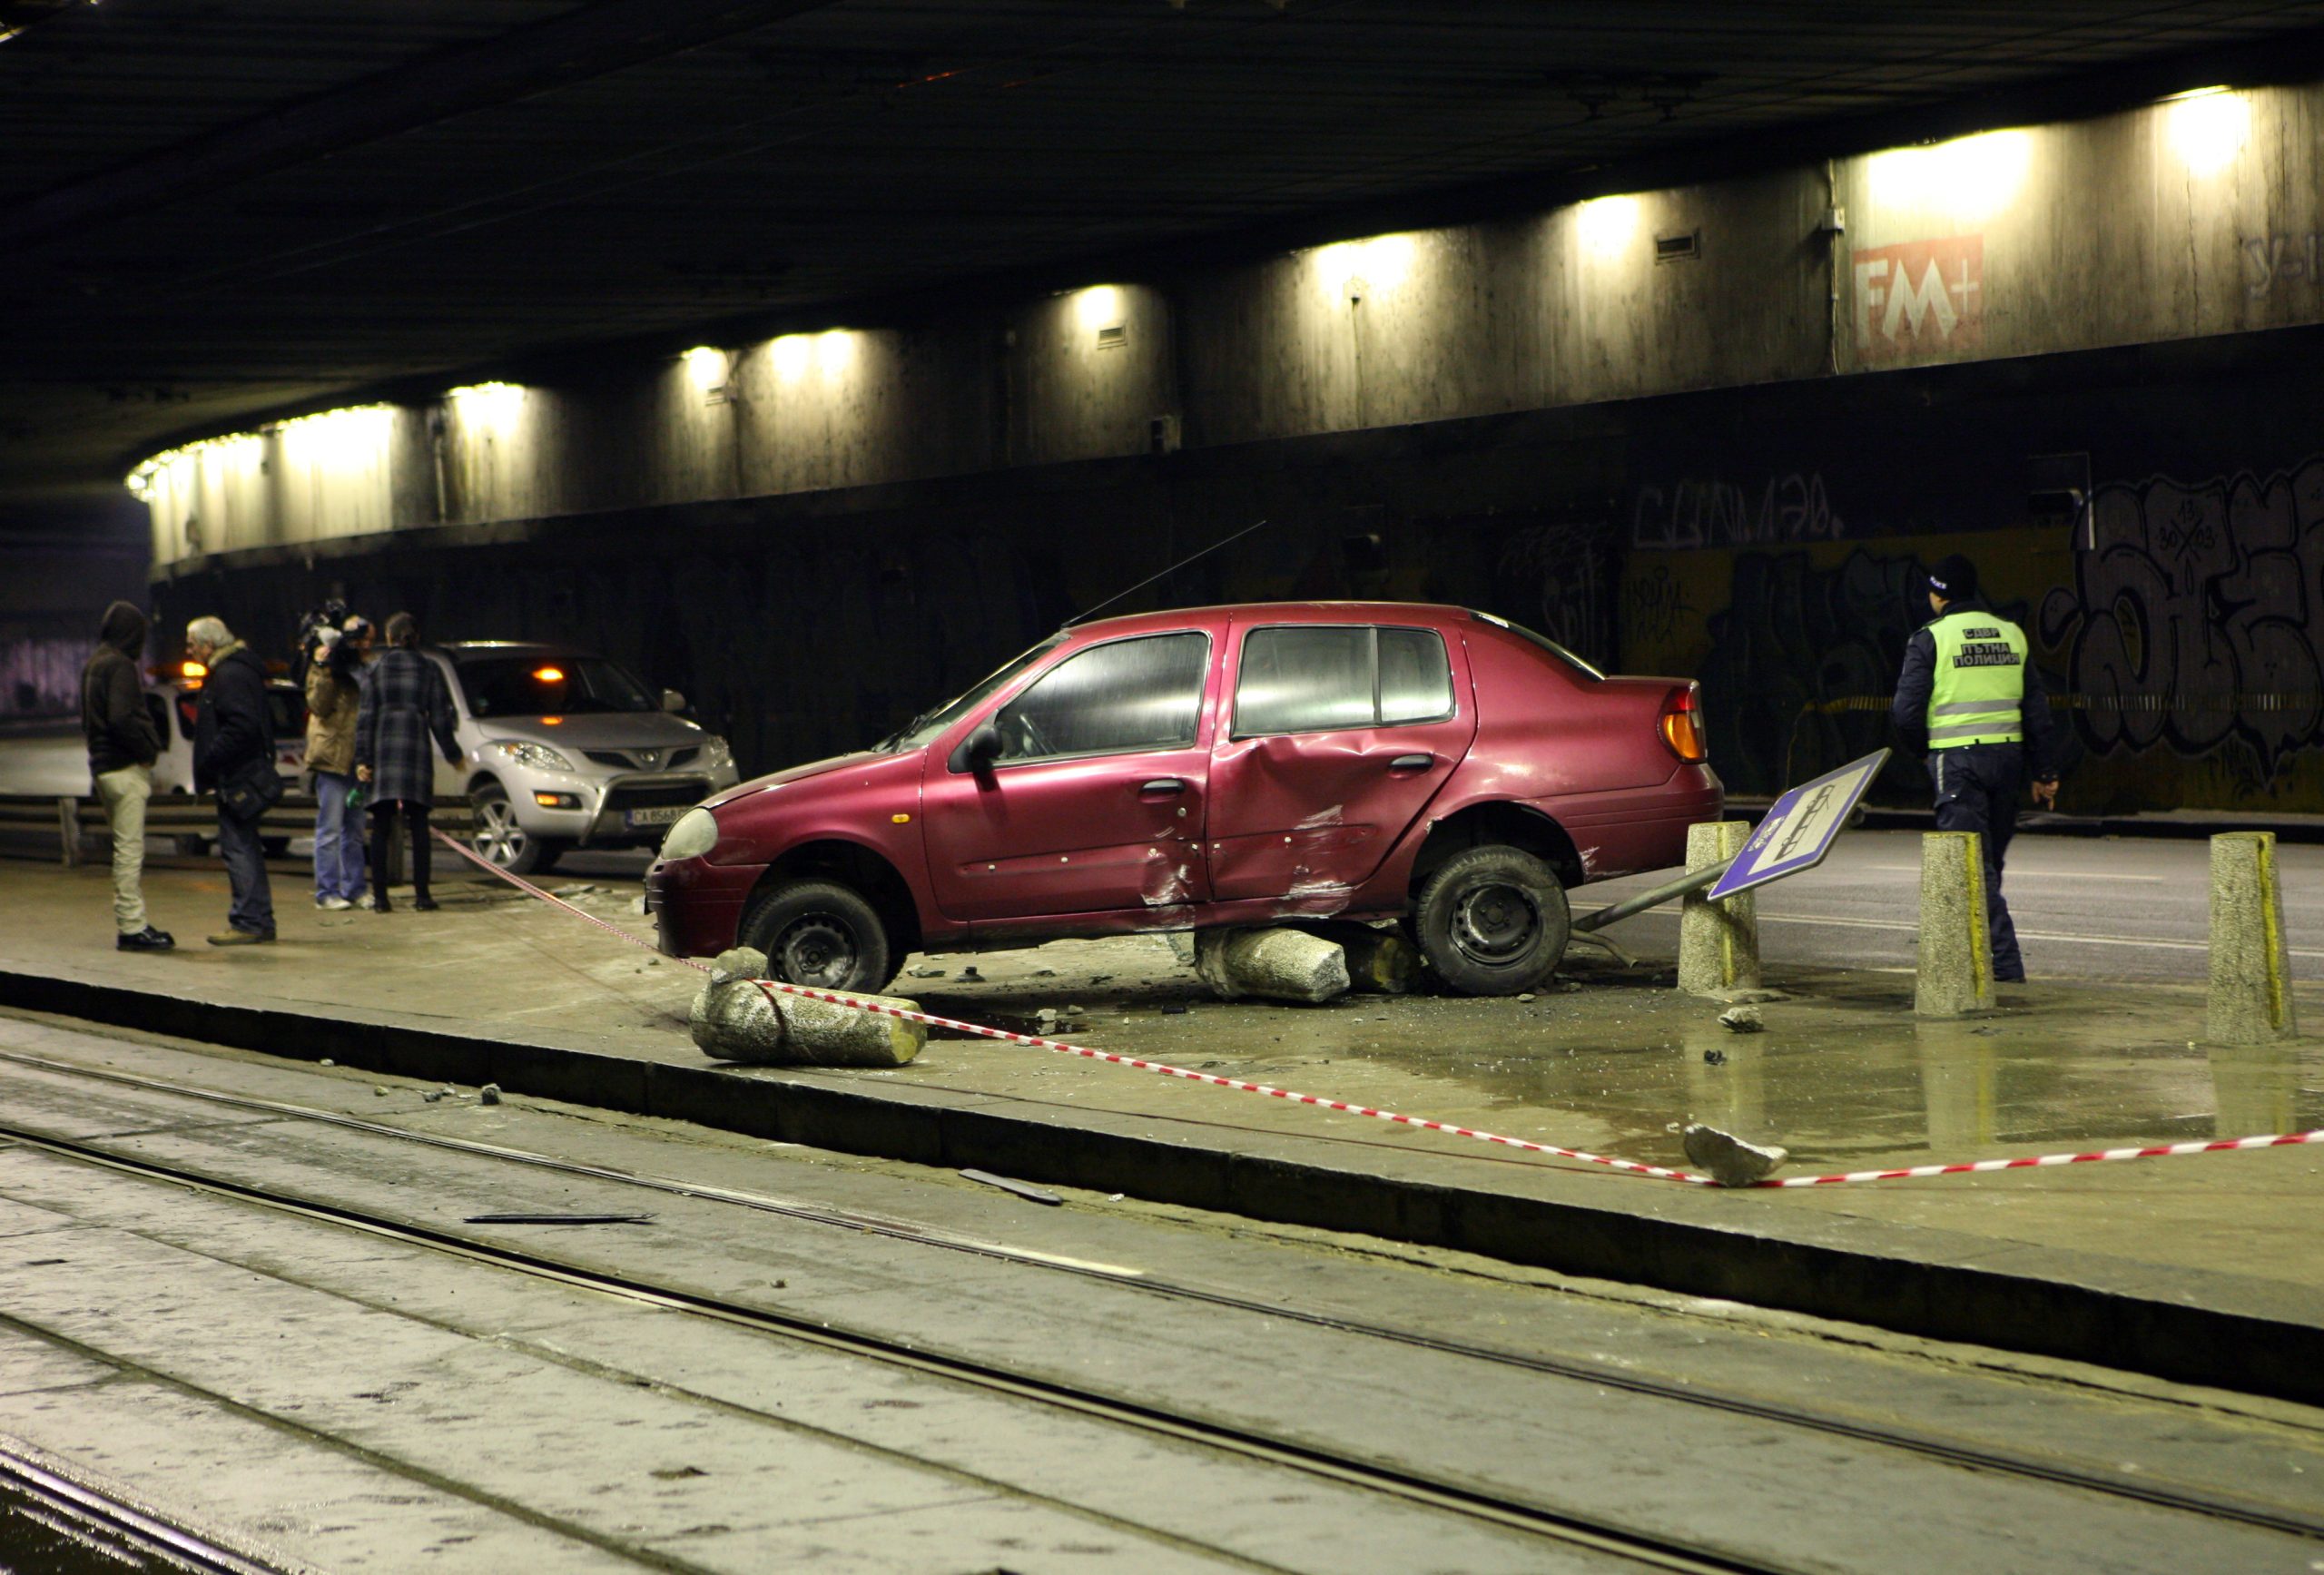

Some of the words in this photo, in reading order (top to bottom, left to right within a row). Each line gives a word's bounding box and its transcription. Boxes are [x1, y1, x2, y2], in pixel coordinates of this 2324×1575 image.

[1965, 627, 1999, 638] СДВР
[1963, 644, 2009, 655] ПЪТНА
[1955, 653, 2019, 666] ПОЛИЦИЯ
